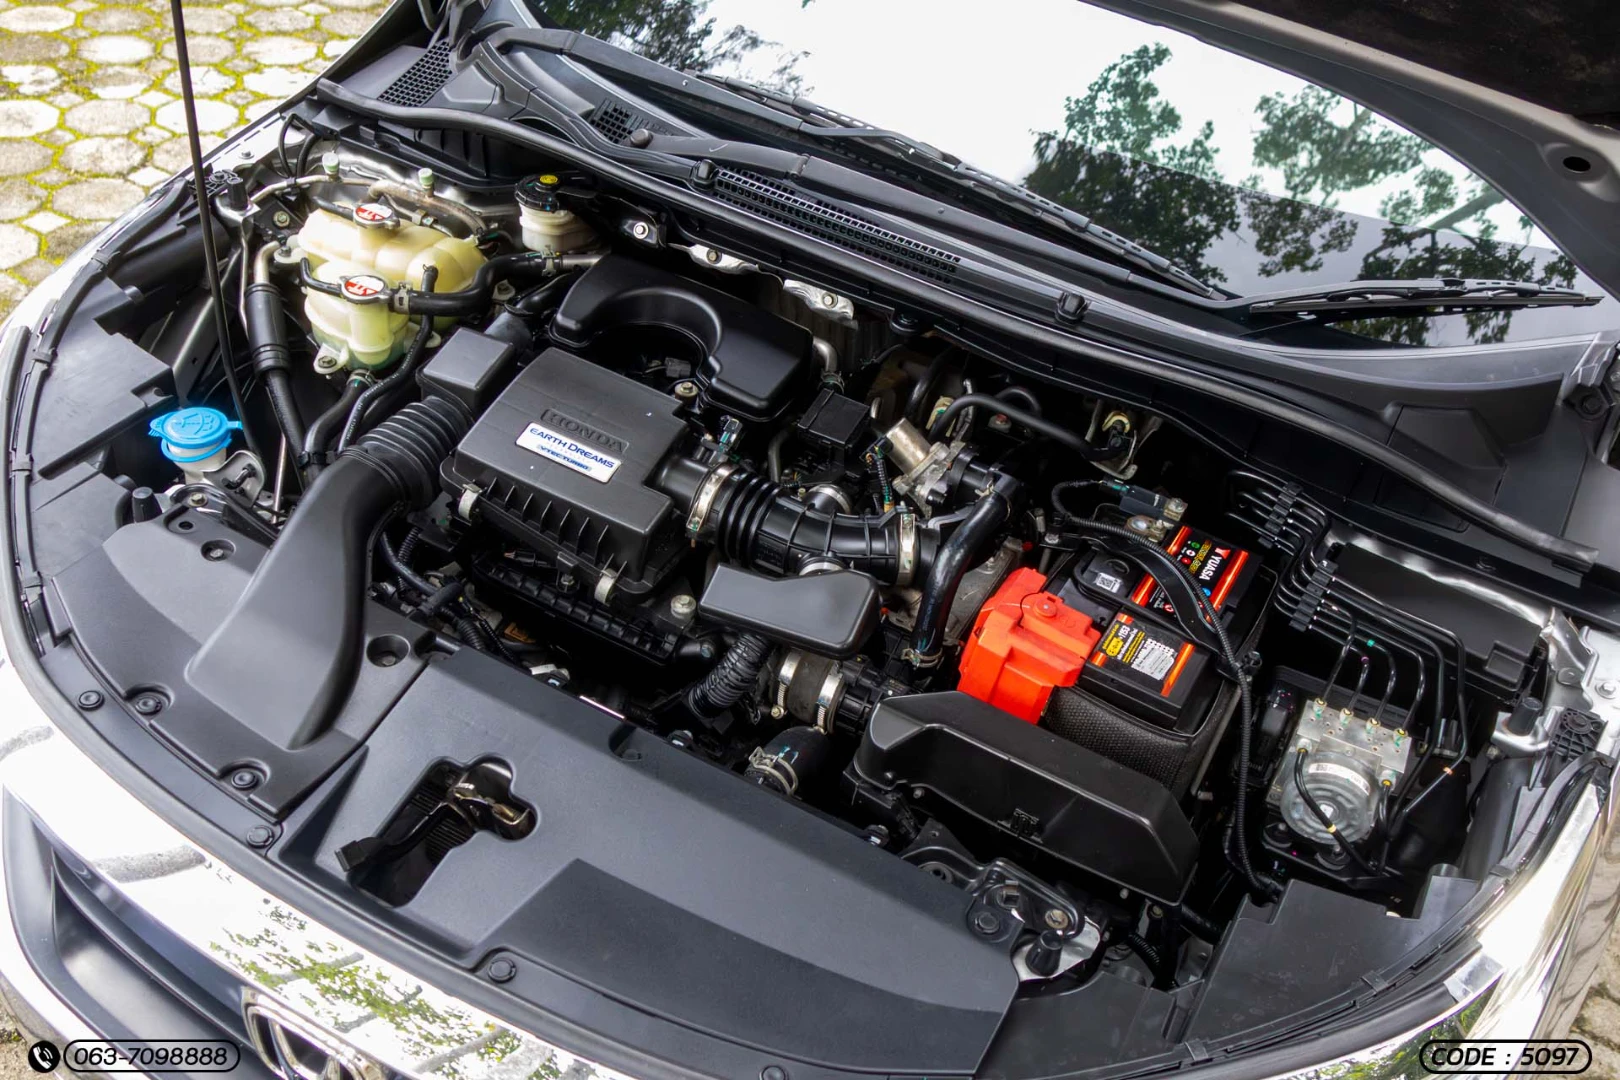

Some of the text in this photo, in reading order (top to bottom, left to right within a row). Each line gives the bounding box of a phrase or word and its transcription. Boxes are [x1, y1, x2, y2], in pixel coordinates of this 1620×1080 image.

[530, 427, 567, 448] EARTH
[567, 442, 615, 469] DREAMS
[548, 412, 624, 454] HONDA
[1198, 556, 1222, 581] YUASA
